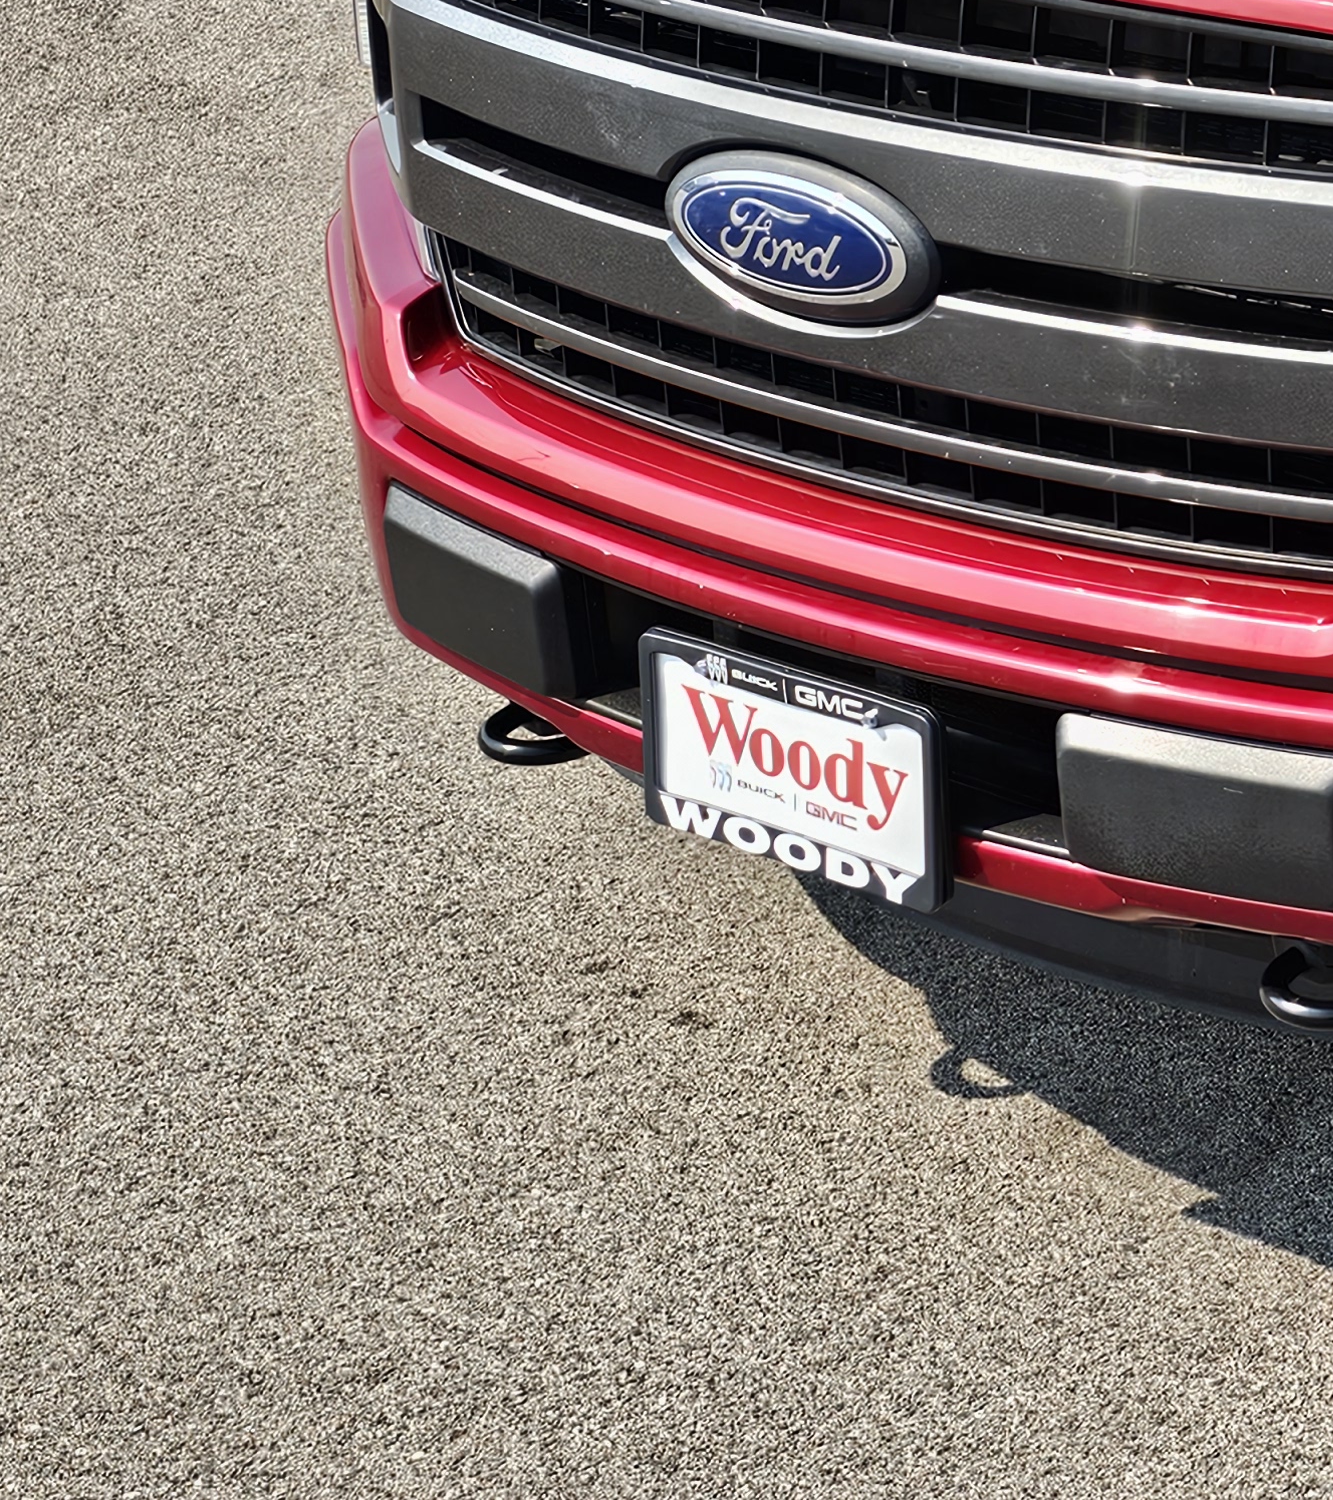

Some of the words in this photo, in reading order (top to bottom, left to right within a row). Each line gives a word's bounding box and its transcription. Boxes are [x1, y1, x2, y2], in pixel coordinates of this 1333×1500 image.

[720, 196, 842, 282] Ford
[730, 668, 778, 692] BUICK
[794, 684, 864, 719] GMC
[681, 684, 909, 831] Woody
[737, 779, 786, 804] BUICK
[805, 801, 858, 832] GMC
[658, 794, 918, 905] WOODY
